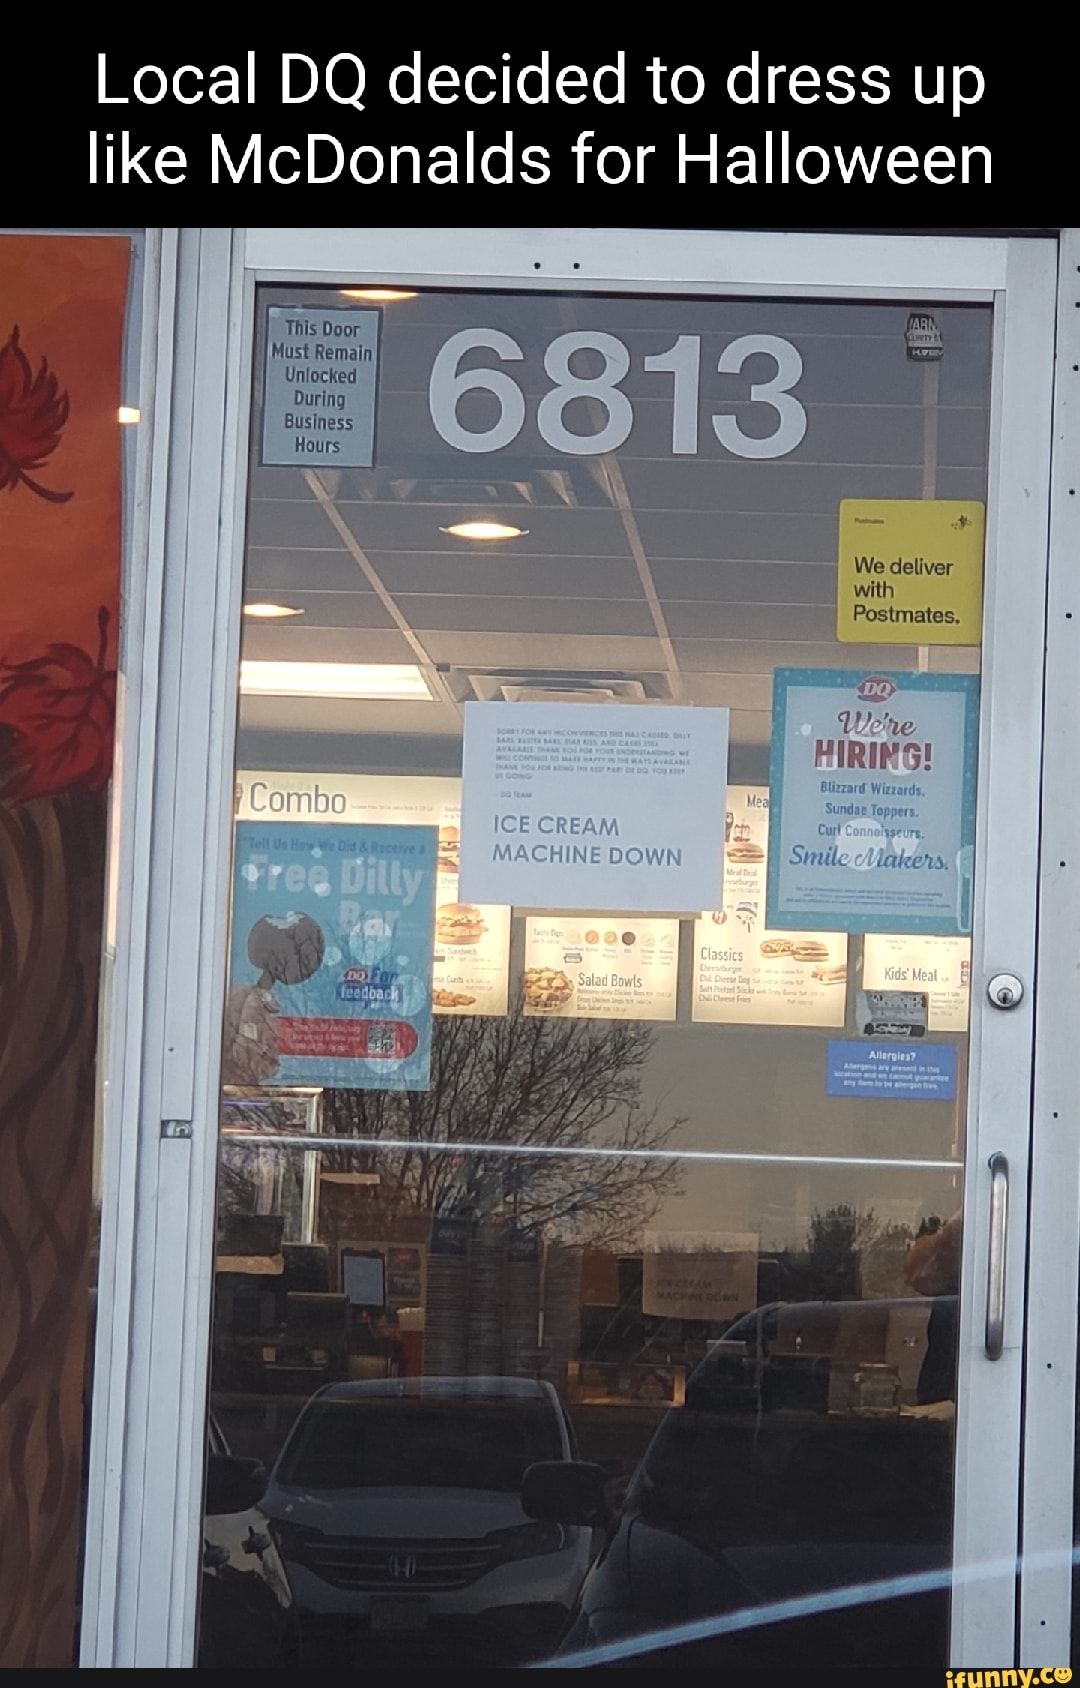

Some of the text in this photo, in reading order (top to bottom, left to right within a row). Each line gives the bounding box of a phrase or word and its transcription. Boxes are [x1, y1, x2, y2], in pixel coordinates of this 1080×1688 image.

[285, 319, 361, 337] This Door
[271, 342, 372, 362] Must Remain
[285, 366, 357, 384] Unlocked
[294, 390, 346, 410] During
[429, 328, 807, 459] 6813
[284, 413, 353, 431] Business
[295, 437, 341, 454] Hours
[854, 556, 954, 576] We deliver
[854, 580, 895, 598] with
[853, 604, 960, 624] Postmates.
[862, 681, 893, 697] DQ
[837, 710, 917, 737] We're
[814, 739, 933, 771] HIRING!
[820, 781, 866, 795] Blizzard
[250, 781, 347, 815] Combo
[747, 793, 769, 808] Mea
[825, 802, 919, 820] Sundae Toppers.
[494, 815, 620, 836] ICE CREAM
[818, 823, 925, 839] Curl Connoisseurs.
[249, 837, 425, 855] Tell Us How We Did & Receive a
[493, 843, 682, 866] MACHINE DOWN
[789, 844, 949, 871] Smile Makers.
[248, 853, 425, 906] Free Dilly
[339, 899, 400, 936] Bar
[701, 947, 743, 961] Classics
[346, 969, 367, 981] DQ
[700, 963, 742, 974] Cheeseburger
[885, 967, 937, 982] Kids' Meal
[578, 972, 642, 988] Salad Bowls
[700, 974, 712, 983] Chili
[715, 975, 736, 983] Cheese
[738, 976, 750, 985] Dog
[341, 984, 399, 1000] feedback
[699, 994, 712, 1002] Chili
[737, 995, 751, 1003] Fries
[700, 985, 712, 993] Soft
[714, 985, 735, 993] Pretzel
[737, 986, 754, 994] Sticks
[868, 1050, 917, 1062] Allergies?
[843, 1062, 876, 1071] Allergens
[891, 1065, 917, 1073] present
[919, 1065, 925, 1073] in
[843, 1080, 856, 1088] any
[858, 1079, 873, 1087] item
[895, 1081, 922, 1089] allergen
[915, 1074, 949, 1082] guarantee
